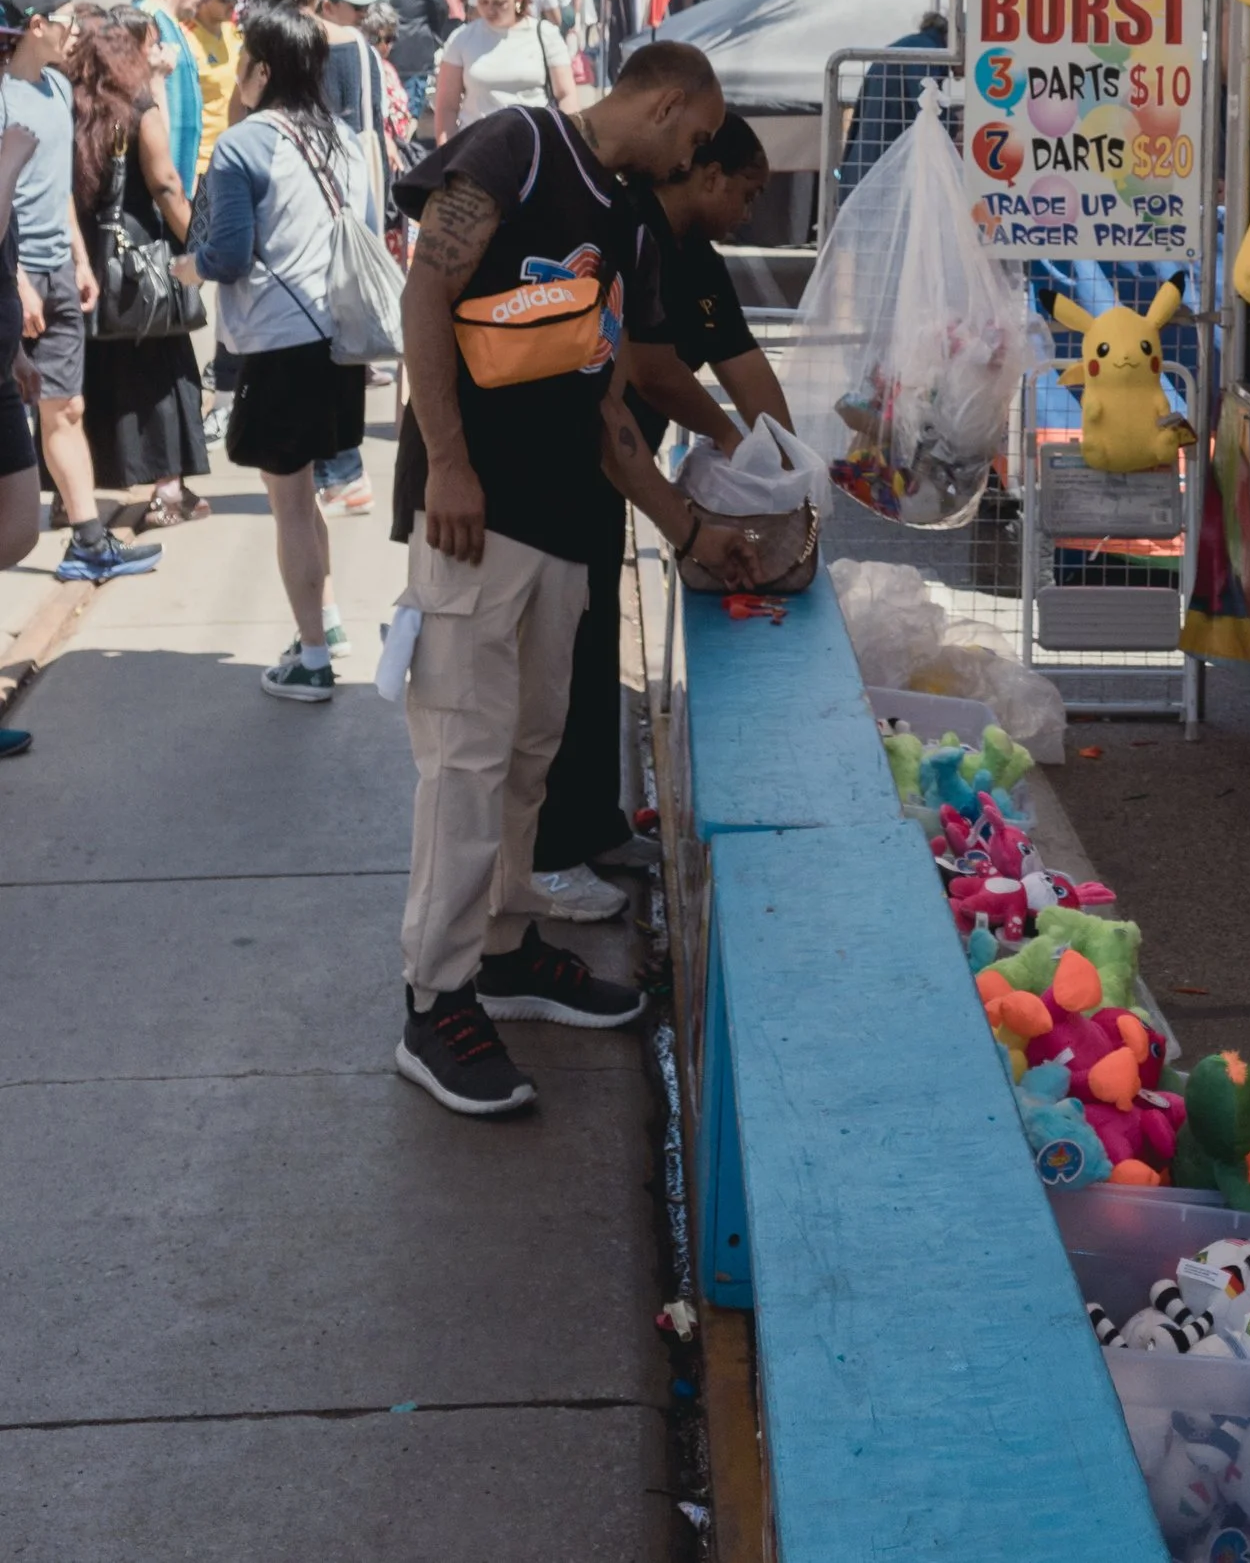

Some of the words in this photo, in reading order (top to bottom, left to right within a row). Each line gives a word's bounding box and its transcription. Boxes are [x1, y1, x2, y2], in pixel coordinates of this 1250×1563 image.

[988, 56, 1014, 99] 3
[1028, 62, 1120, 102] DARTS
[1129, 63, 1192, 109] $10
[984, 130, 1009, 171] 7
[1032, 136, 1125, 173] DARTS
[1131, 135, 1194, 179] $20
[982, 192, 1066, 217] TRADE
[1081, 193, 1117, 217] UP
[1132, 194, 1184, 218] FOR
[978, 223, 1079, 247] LARGER
[1093, 223, 1187, 247] PRIZES
